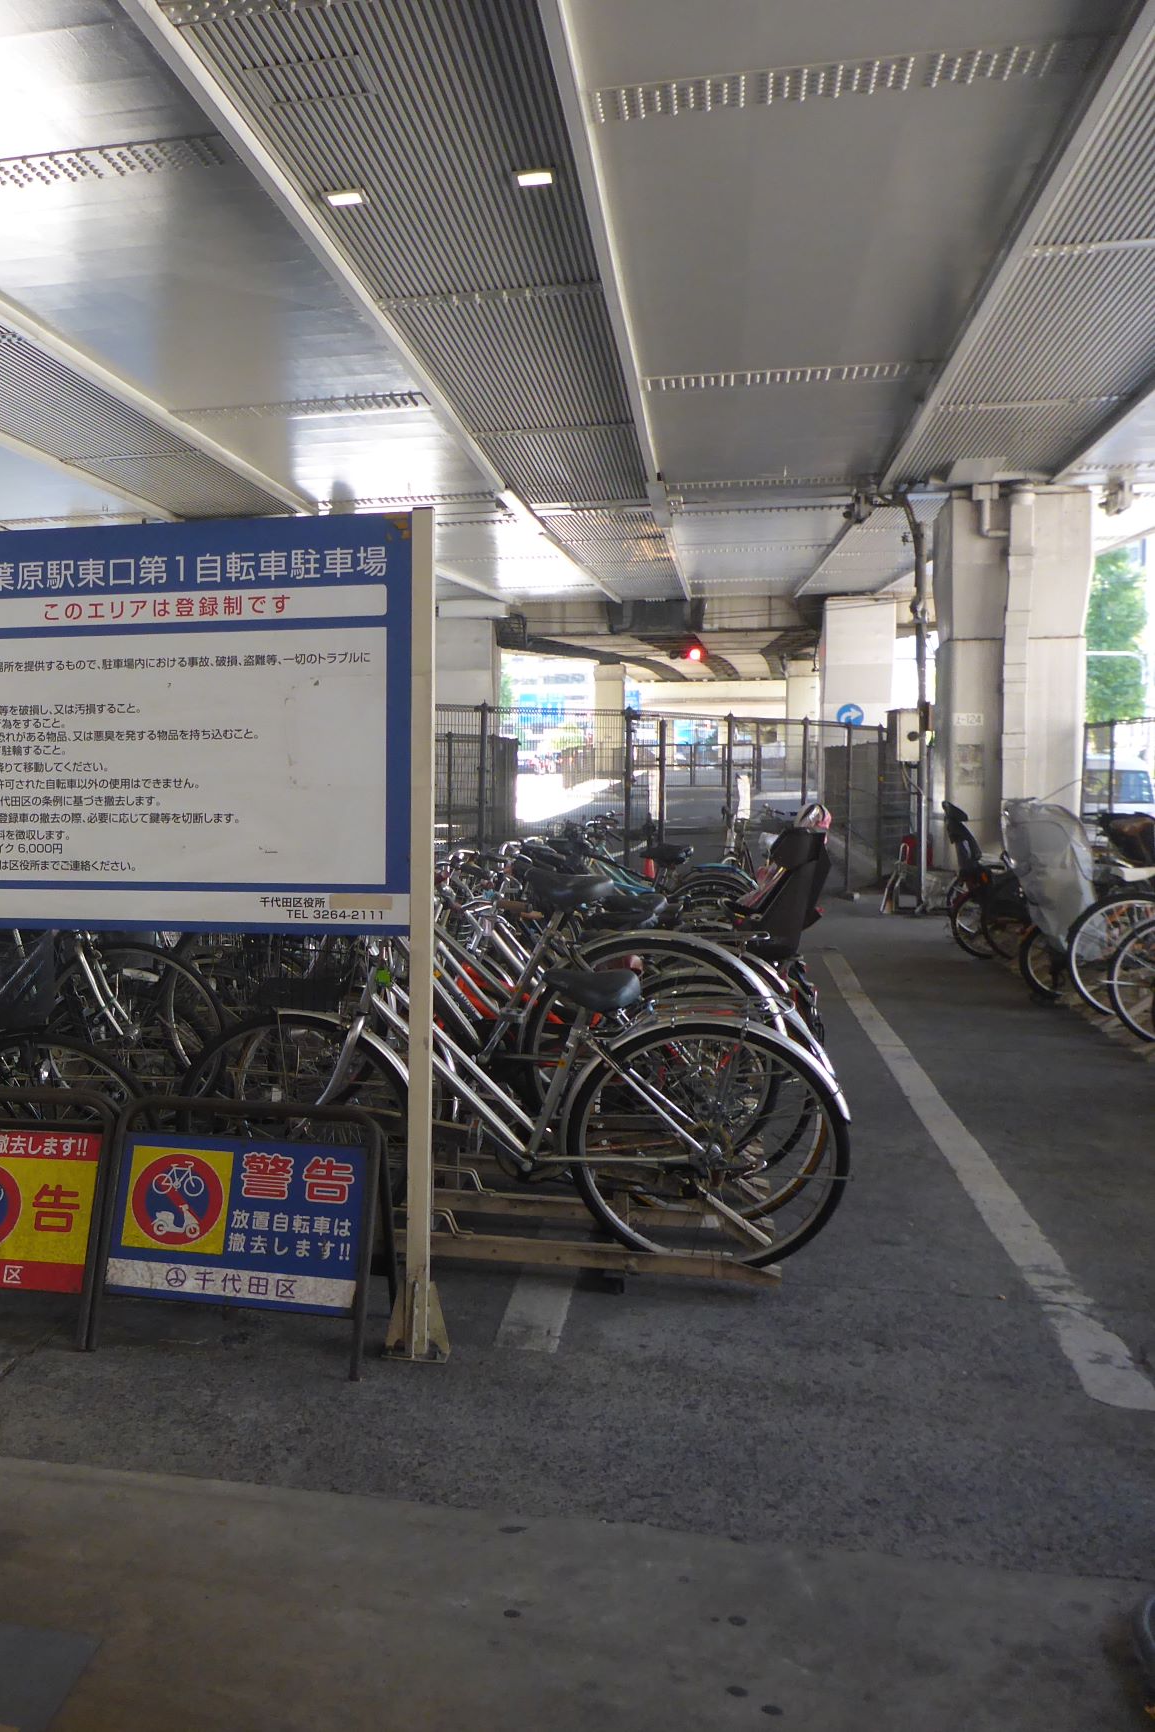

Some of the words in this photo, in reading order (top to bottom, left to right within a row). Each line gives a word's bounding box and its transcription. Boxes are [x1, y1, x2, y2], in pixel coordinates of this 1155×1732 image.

[44, 594, 291, 622] このエリアは登録制です
[259, 896, 326, 908] 千代田区役所
[286, 909, 309, 919] TEL
[313, 909, 384, 920] 3264-2111
[241, 1152, 355, 1205] 警告
[231, 1209, 352, 1237] 放置自転車は
[228, 1232, 350, 1262] 撤去します!!
[194, 1270, 297, 1299] 千代田区
